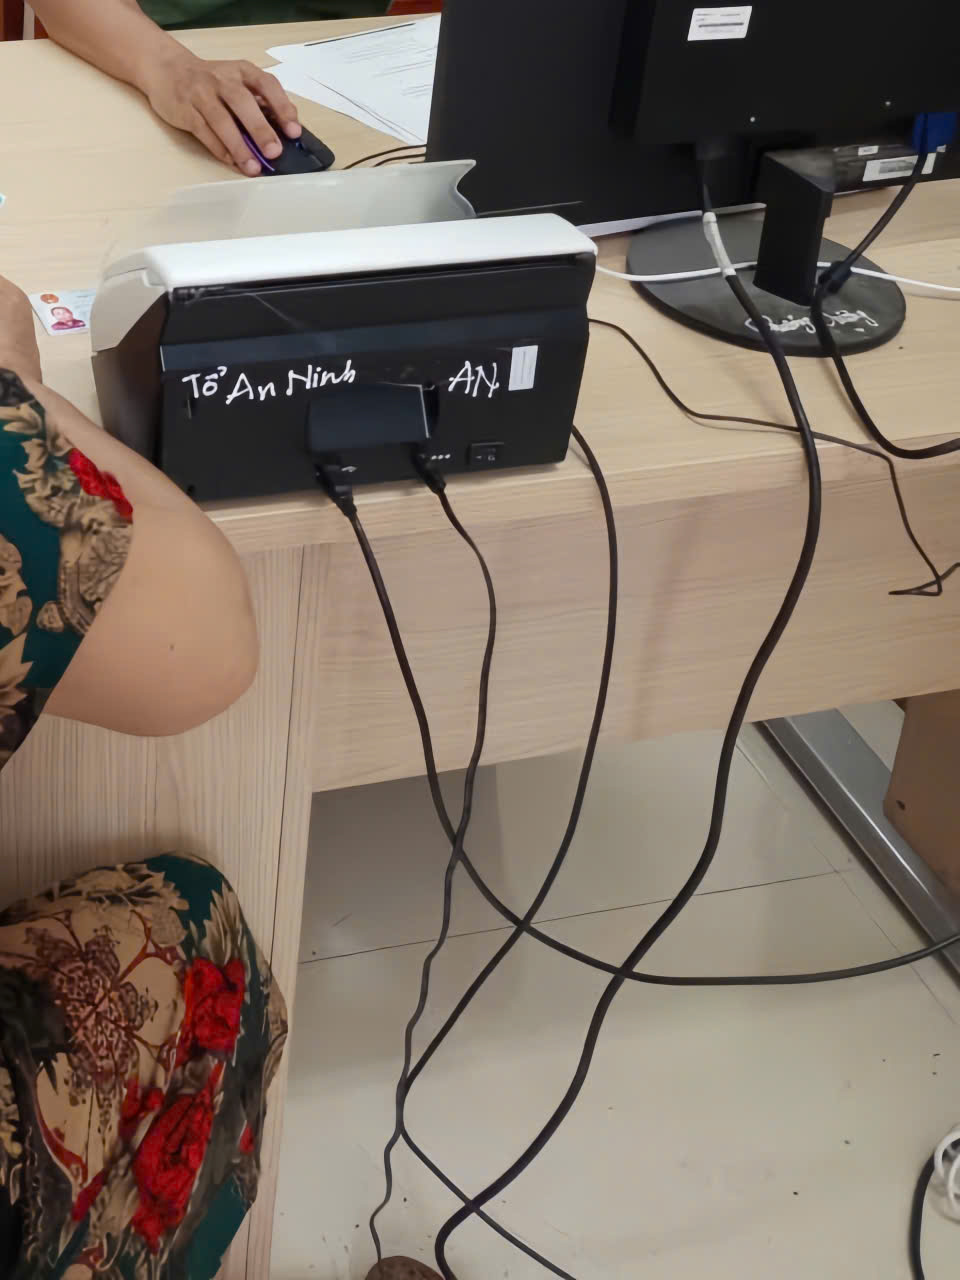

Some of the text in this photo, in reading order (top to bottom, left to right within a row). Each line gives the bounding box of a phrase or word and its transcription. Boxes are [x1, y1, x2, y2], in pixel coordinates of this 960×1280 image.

[182, 359, 356, 405] Tổ An Ninh
[448, 360, 500, 398] AN
